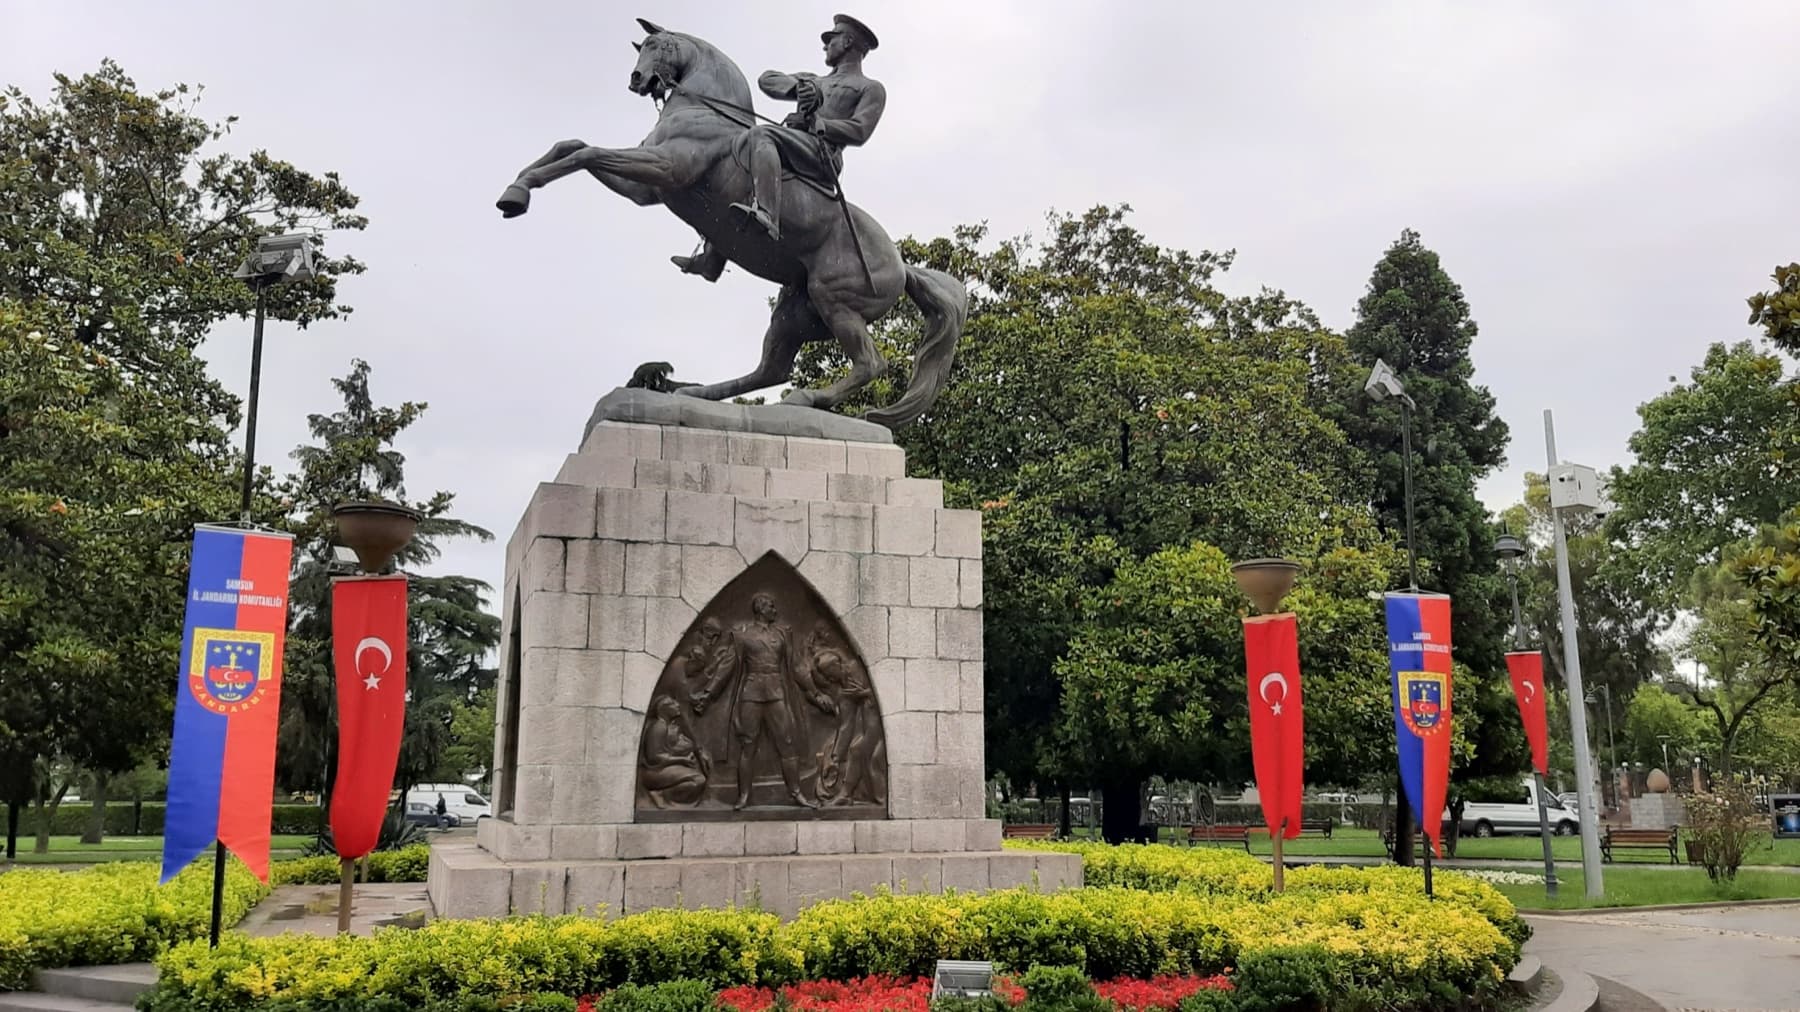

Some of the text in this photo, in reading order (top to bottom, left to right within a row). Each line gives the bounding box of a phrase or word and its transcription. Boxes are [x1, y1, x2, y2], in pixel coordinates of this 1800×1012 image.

[226, 578, 254, 591] SAMSUN
[201, 591, 238, 604] JANDARMA
[194, 684, 266, 713] JANDARMA
